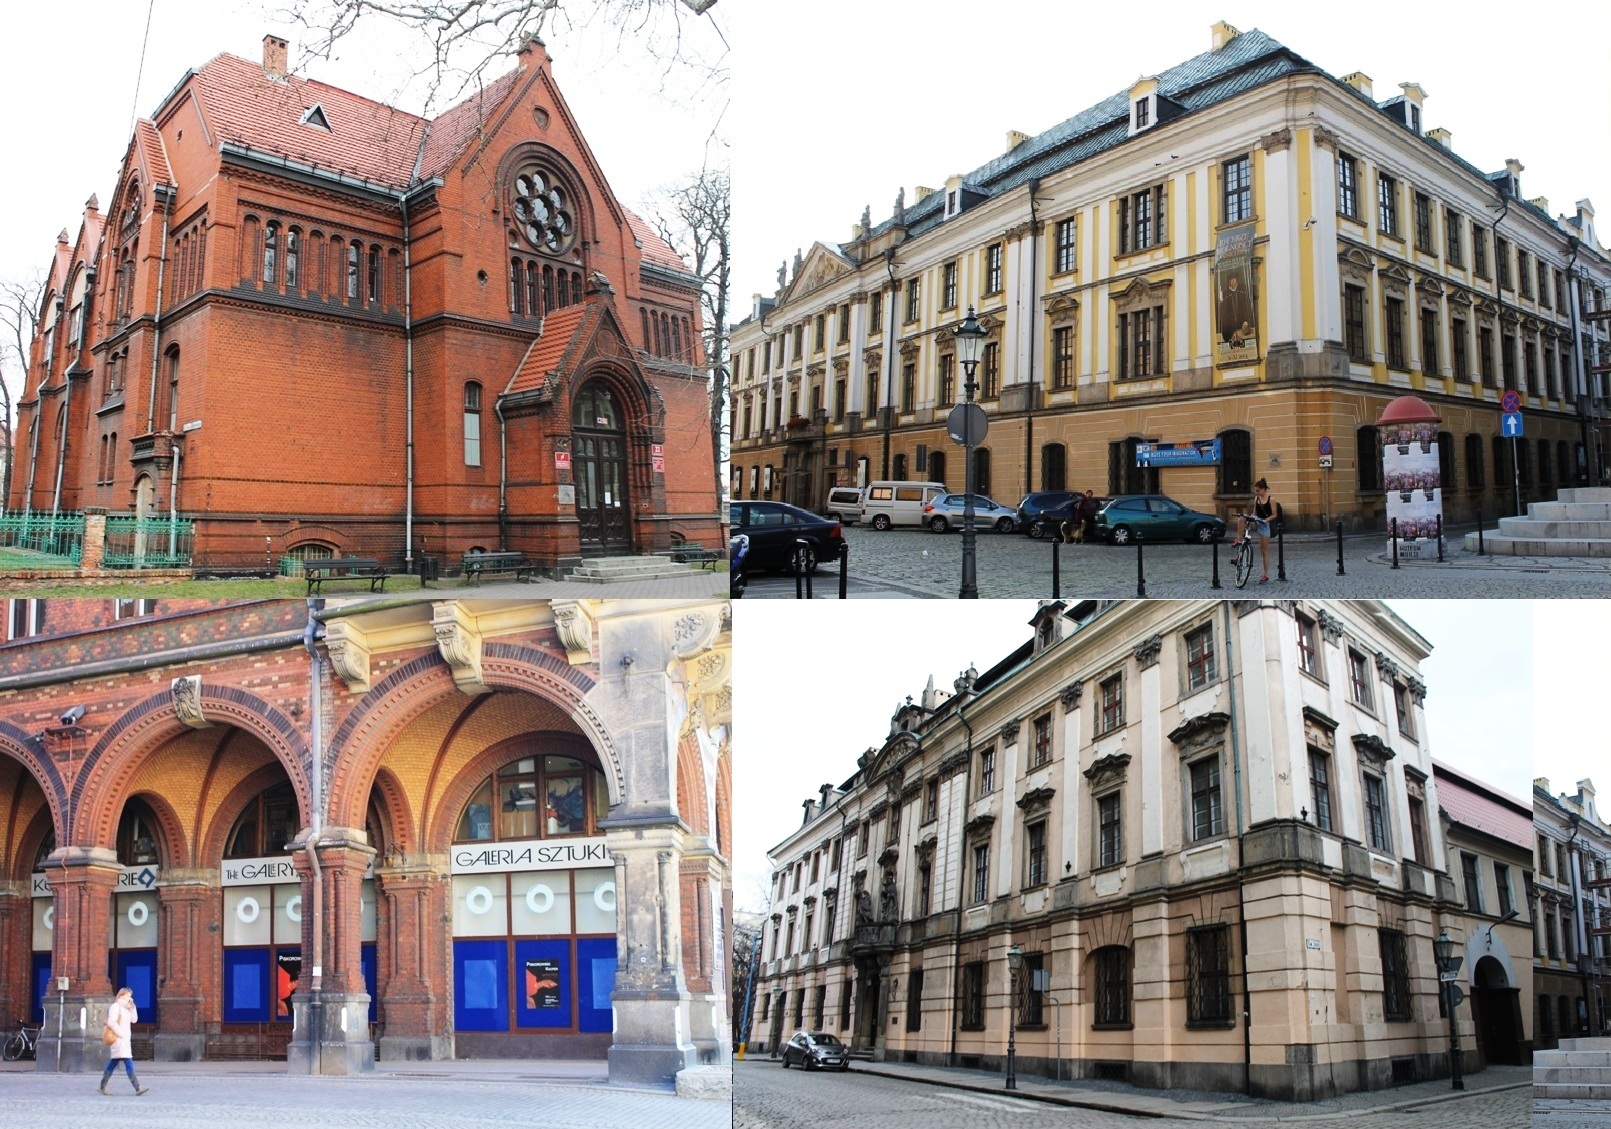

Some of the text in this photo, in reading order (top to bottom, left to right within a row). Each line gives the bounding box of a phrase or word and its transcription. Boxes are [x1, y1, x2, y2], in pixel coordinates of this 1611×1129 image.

[455, 844, 606, 867] GALERIA SZTUKI
[225, 870, 239, 880] THE
